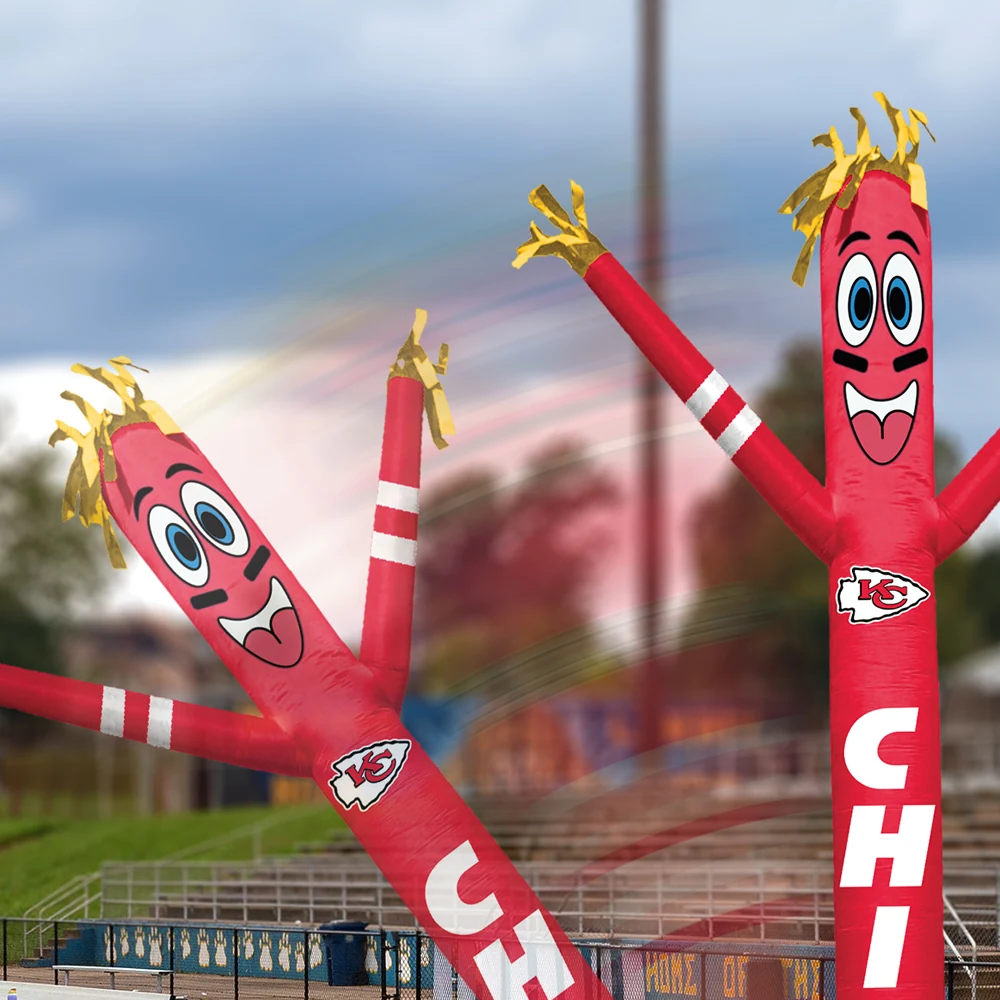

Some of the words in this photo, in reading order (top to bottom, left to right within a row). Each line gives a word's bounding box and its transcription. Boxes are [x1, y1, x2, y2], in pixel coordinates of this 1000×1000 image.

[858, 579, 908, 610] KC
[345, 748, 396, 788] KC
[723, 955, 749, 998] OF
